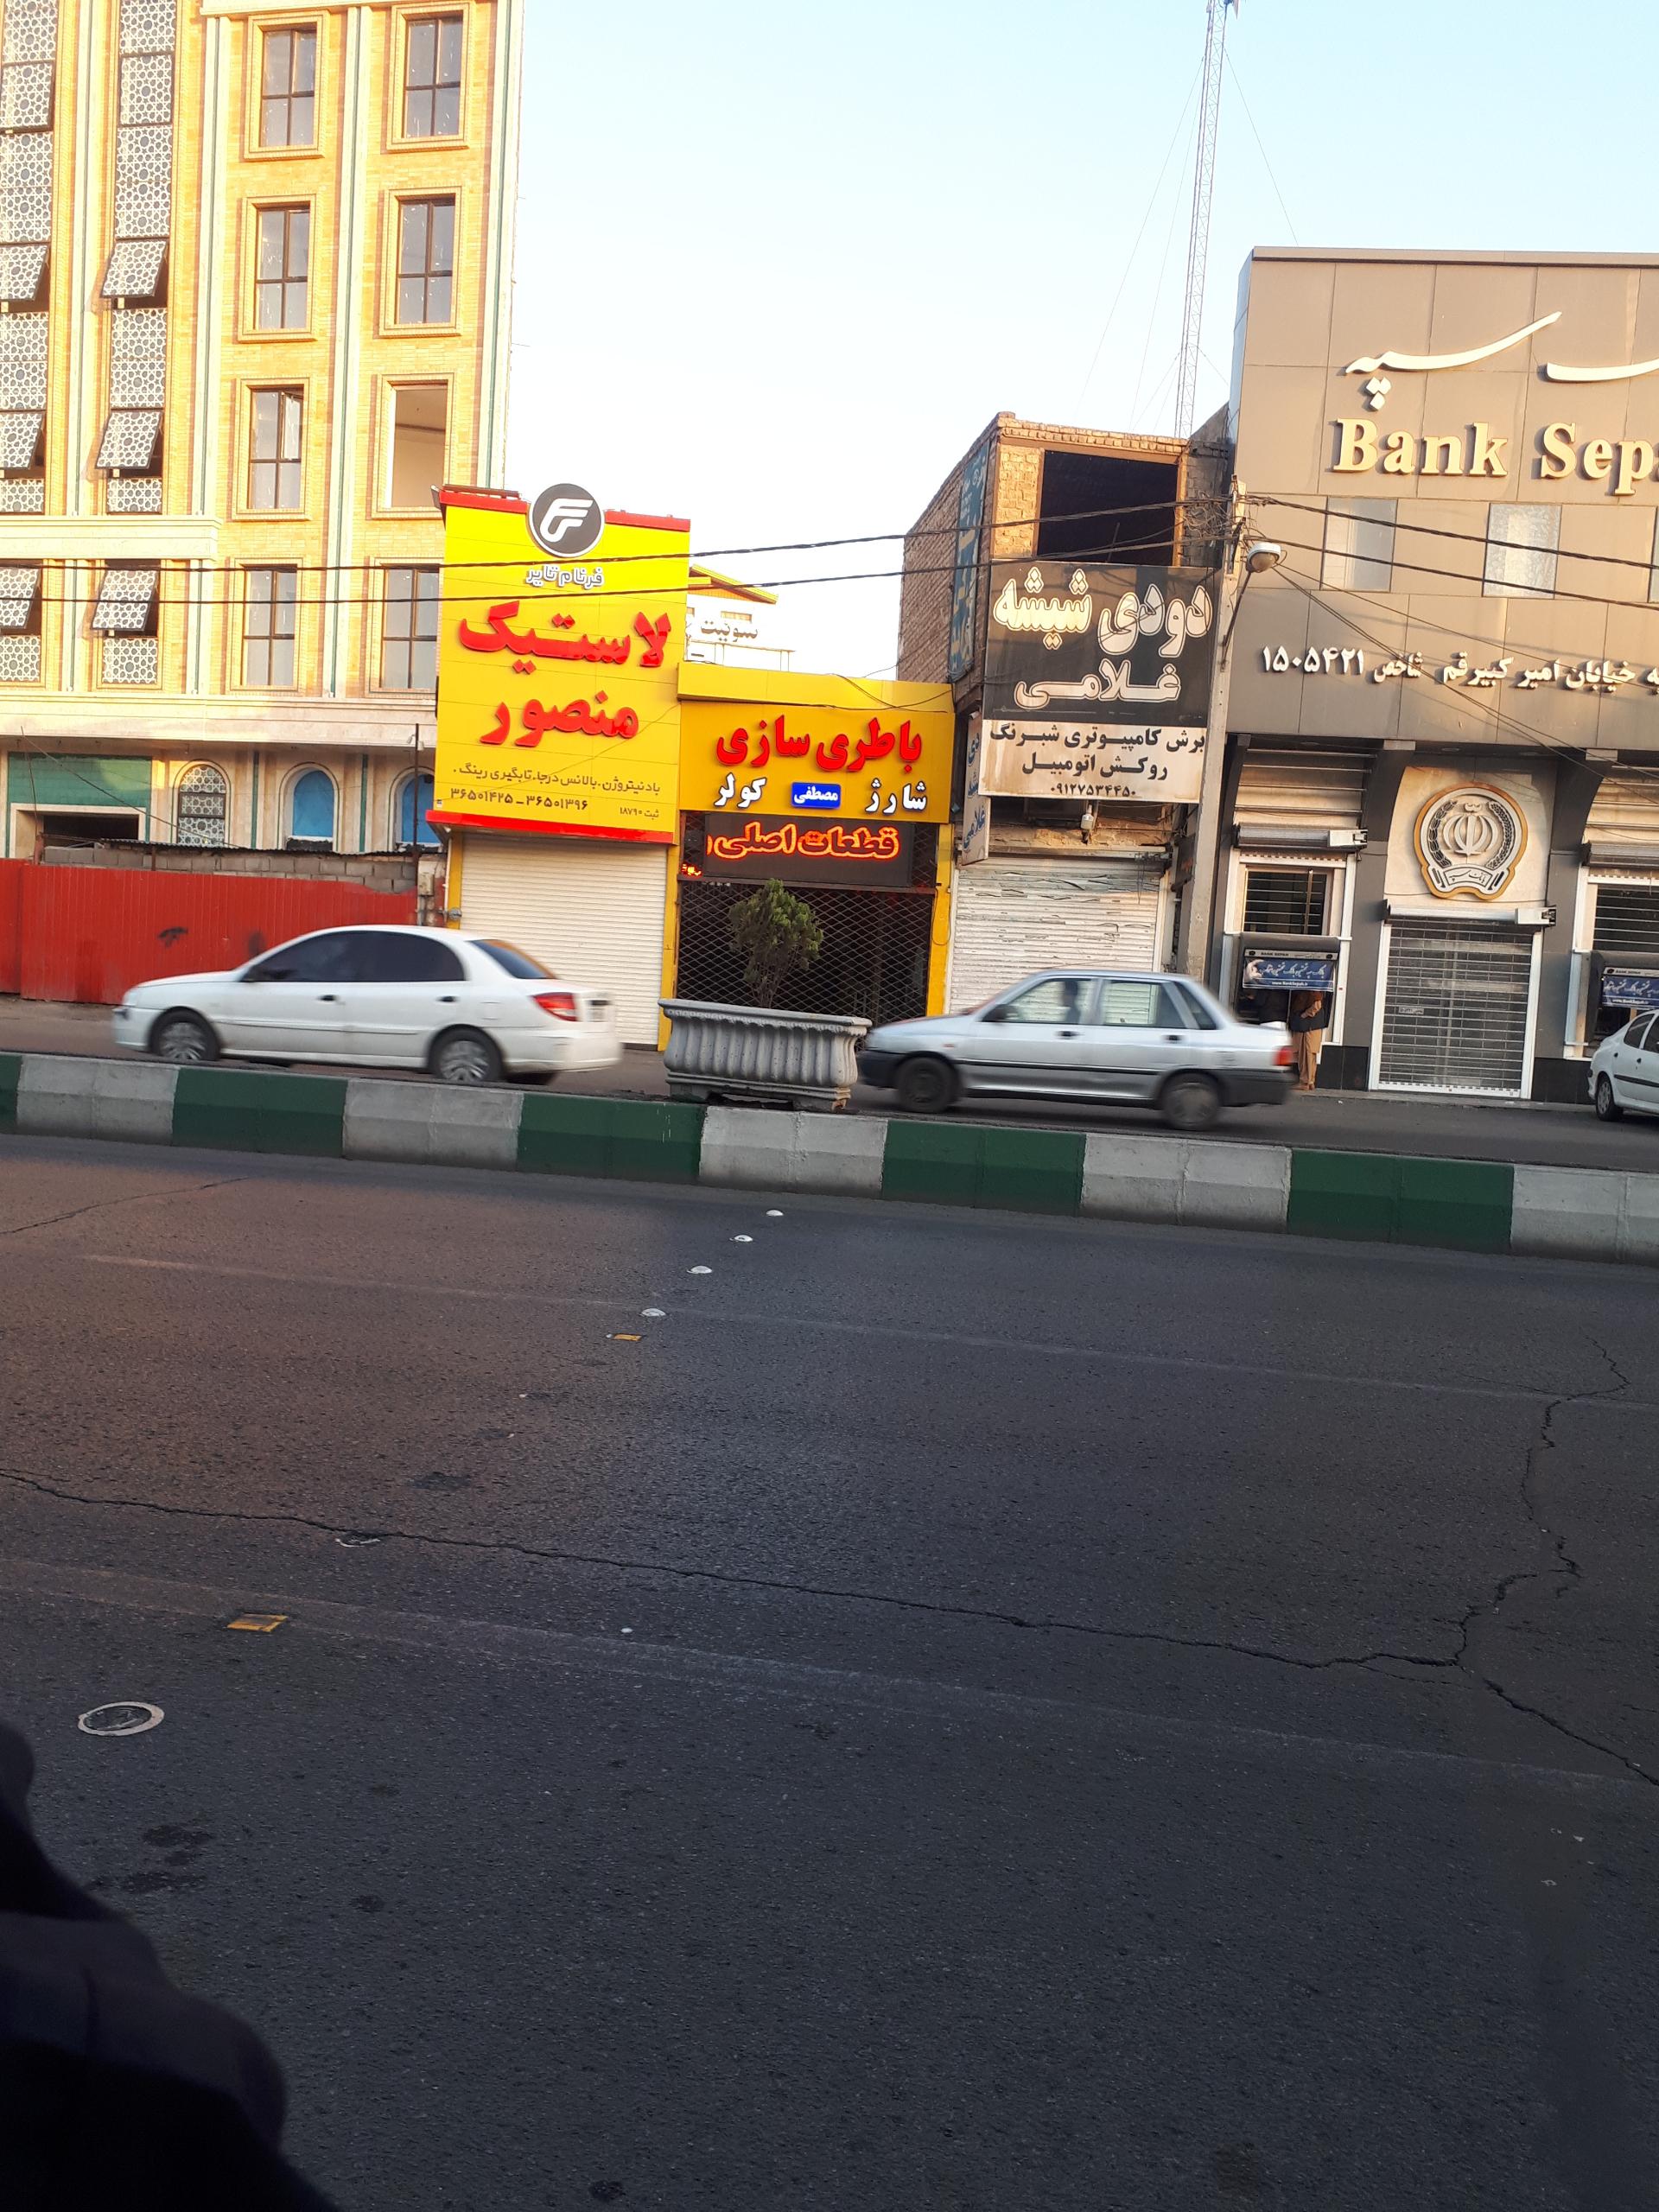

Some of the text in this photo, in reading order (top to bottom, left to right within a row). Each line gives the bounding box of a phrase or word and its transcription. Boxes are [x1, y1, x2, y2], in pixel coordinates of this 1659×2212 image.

[1333, 417, 1659, 496] Bank Sep
[525, 564, 605, 589] فرنام تایر
[993, 567, 1212, 658] دودی شیشه
[459, 600, 671, 675] لاستیک
[1262, 645, 1364, 675] ۱۵۰۵۴۲۱
[1373, 651, 1424, 683] شاخص
[1443, 651, 1468, 683] قم
[1466, 657, 1514, 687] کبیر
[1517, 658, 1560, 689] امیر
[1014, 658, 1181, 709] غلامی
[1566, 660, 1636, 693] خیابان
[480, 690, 639, 747] منصور
[716, 715, 922, 773] باطری سازی
[989, 722, 1205, 753] برش کامپیوتری شبرنگ
[1022, 752, 1167, 780] روکش اتومبیل
[560, 775, 597, 790] بالانس
[714, 772, 767, 809] کولر
[793, 785, 838, 804] مصطفی
[865, 778, 927, 814] شارژ
[1051, 782, 1136, 798] ۰۹۱۲۷۵۳۴۴۵۰
[712, 822, 900, 860] قطعات اصلی
